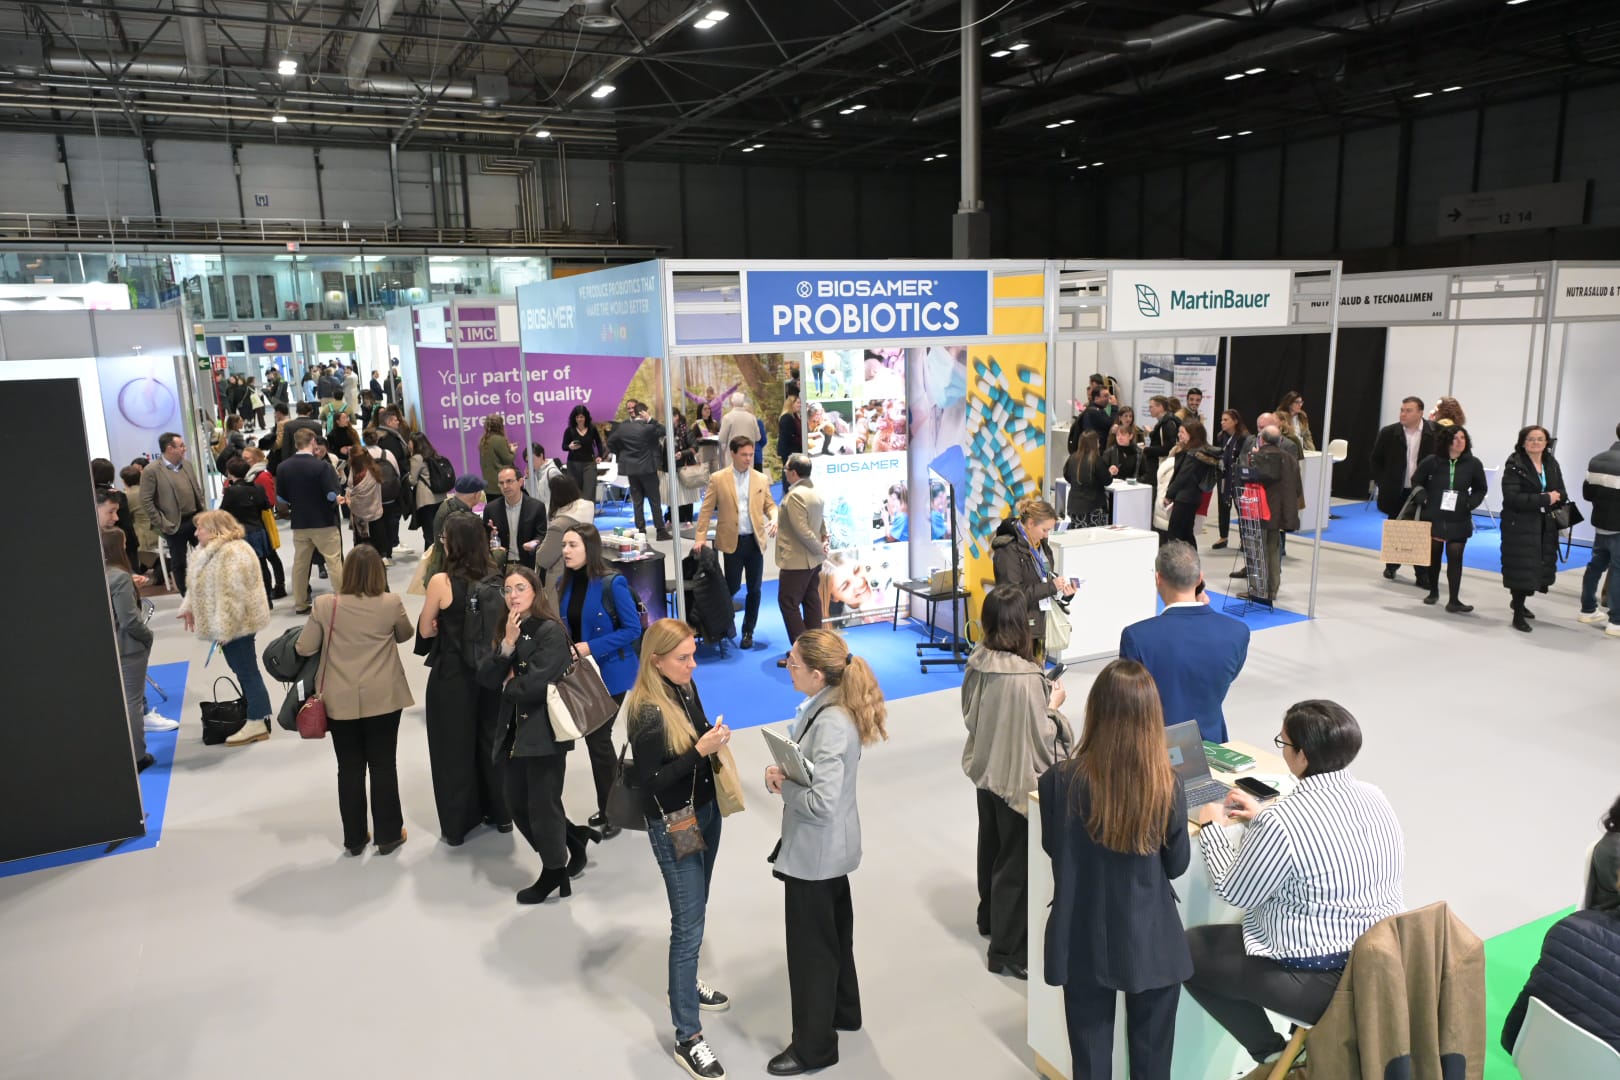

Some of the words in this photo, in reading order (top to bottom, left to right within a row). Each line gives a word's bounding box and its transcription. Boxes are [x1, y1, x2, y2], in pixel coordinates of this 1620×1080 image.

[1497, 212, 1512, 224] 12
[1518, 210, 1532, 222] 14
[817, 279, 934, 298] BIOSAMER
[1364, 296, 1370, 304] &
[1373, 292, 1433, 304] TECNOALIMEN
[1566, 286, 1608, 297] NUTRASALUD
[1610, 286, 1614, 296] &
[1170, 288, 1270, 310] MartinBauer
[527, 304, 575, 330] BIOSAMER
[772, 301, 960, 335] PROBIOTICS
[438, 370, 477, 385] Your
[553, 365, 571, 380] of
[440, 390, 500, 408] choice
[533, 386, 592, 406] quality
[826, 459, 899, 474] BIOSAMER
